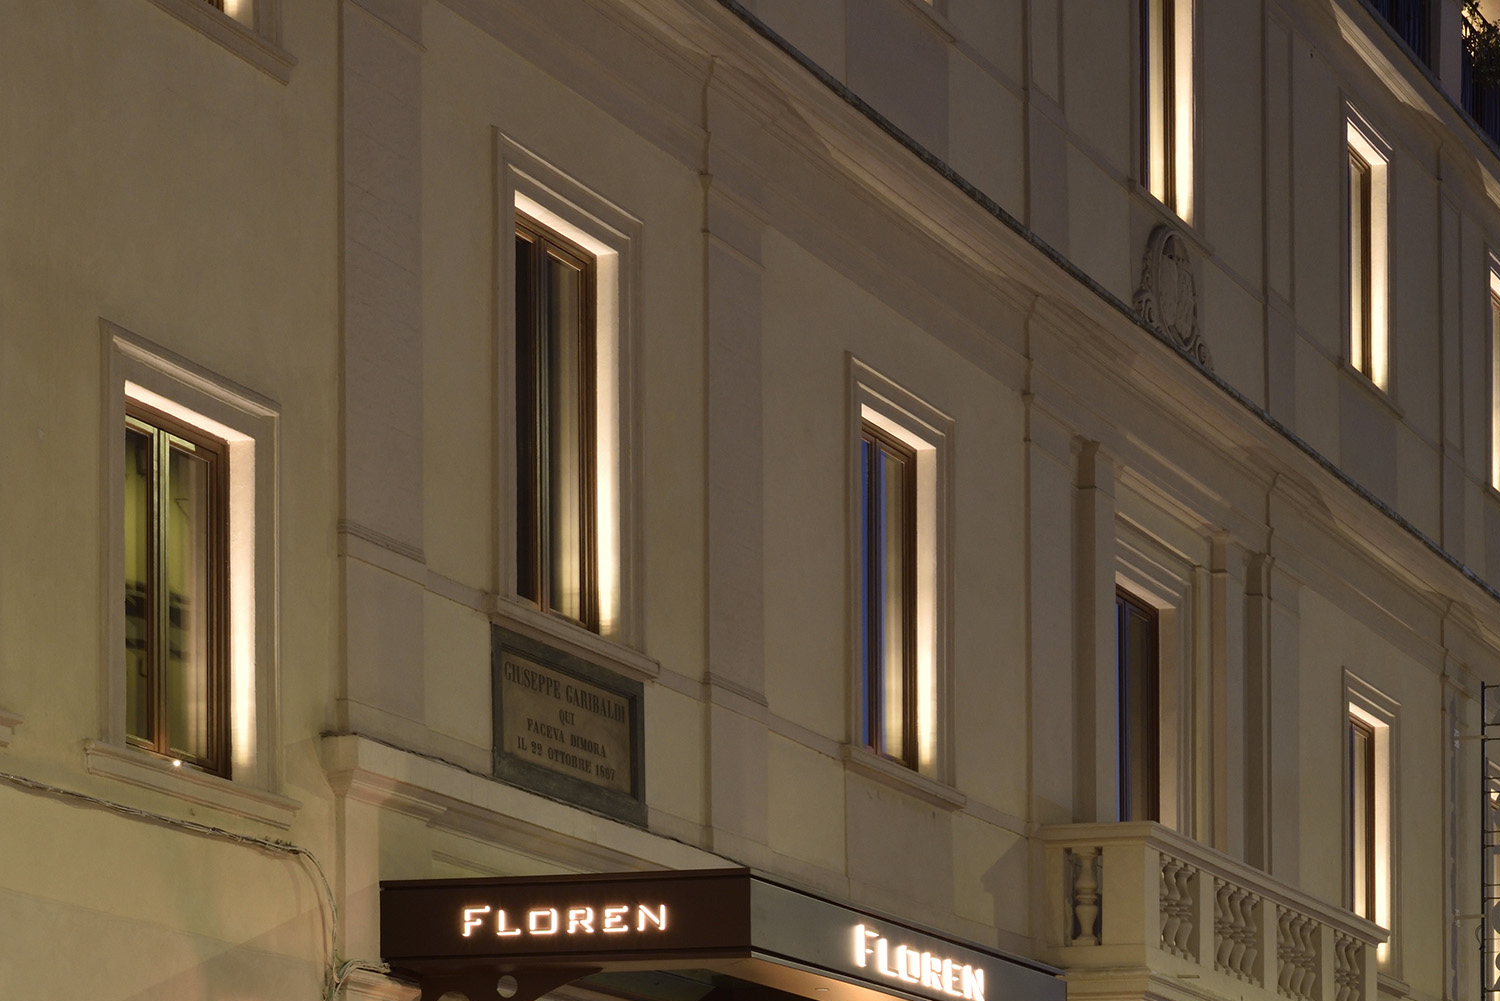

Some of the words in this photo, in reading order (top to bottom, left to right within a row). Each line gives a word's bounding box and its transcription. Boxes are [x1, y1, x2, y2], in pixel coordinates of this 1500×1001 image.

[504, 661, 561, 700] GIUSEPPE
[565, 684, 626, 724] GARIBALDI
[526, 717, 566, 744] FACEVA
[570, 733, 607, 758] DIMORA
[558, 708, 575, 726] QUI
[517, 735, 528, 751] IL
[530, 740, 543, 756] 22
[547, 746, 592, 774] OTTOBRE
[595, 763, 616, 781] 1867
[462, 904, 666, 937] FLOREN
